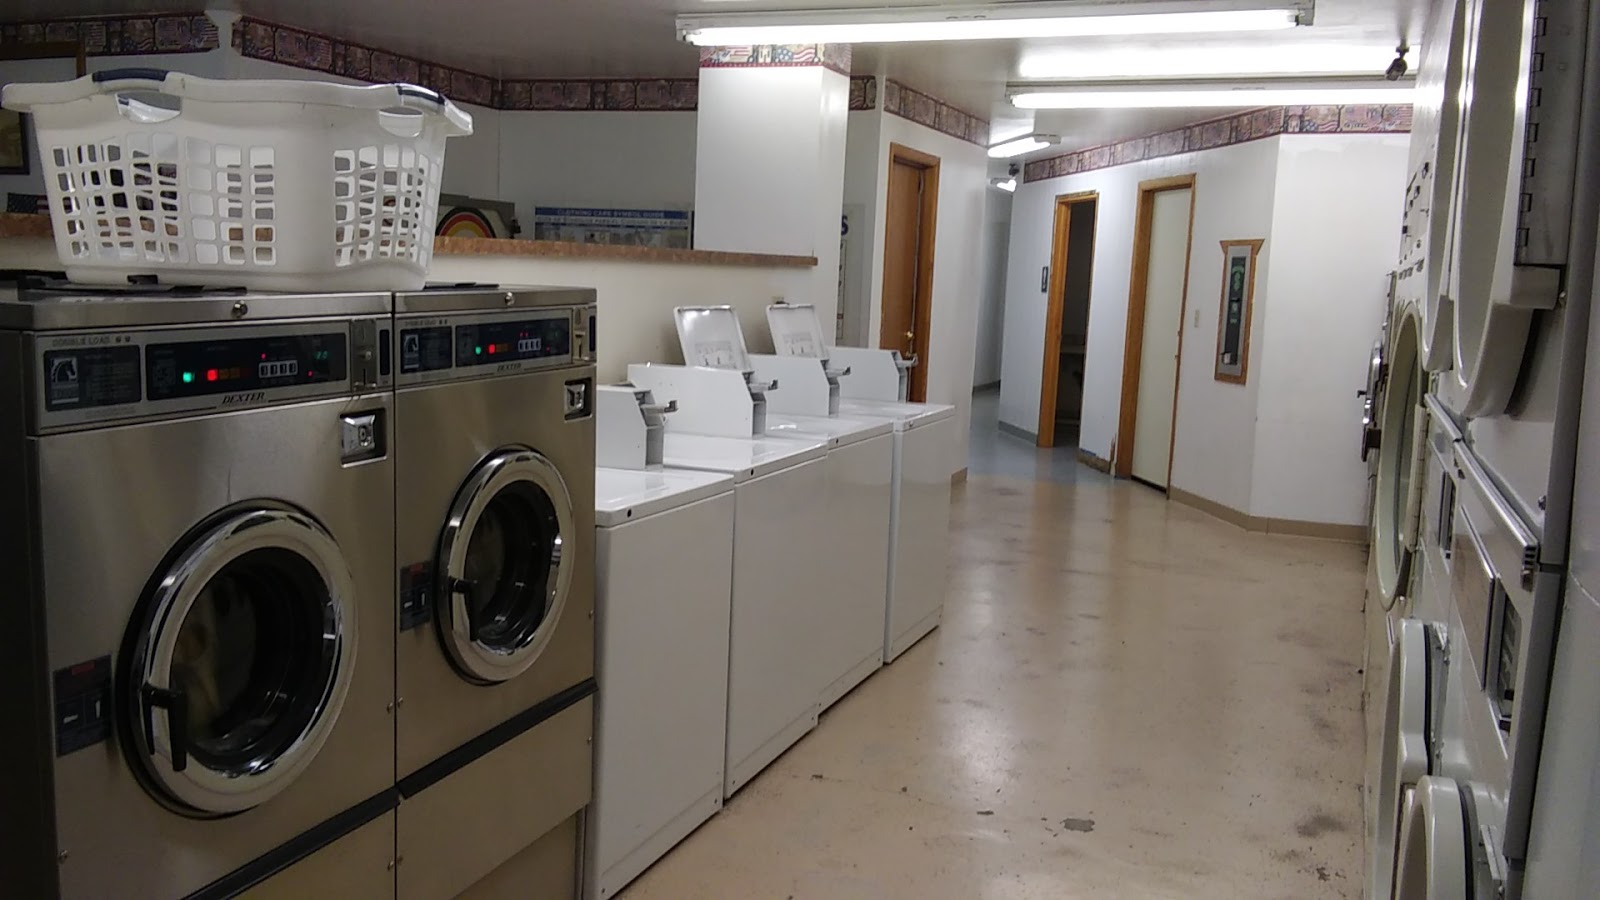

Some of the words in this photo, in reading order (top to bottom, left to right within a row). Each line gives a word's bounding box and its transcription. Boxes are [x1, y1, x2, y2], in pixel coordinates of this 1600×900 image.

[558, 209, 592, 217] CLOTHING
[497, 363, 522, 372] DEXTER
[222, 392, 265, 404] DEXTER
